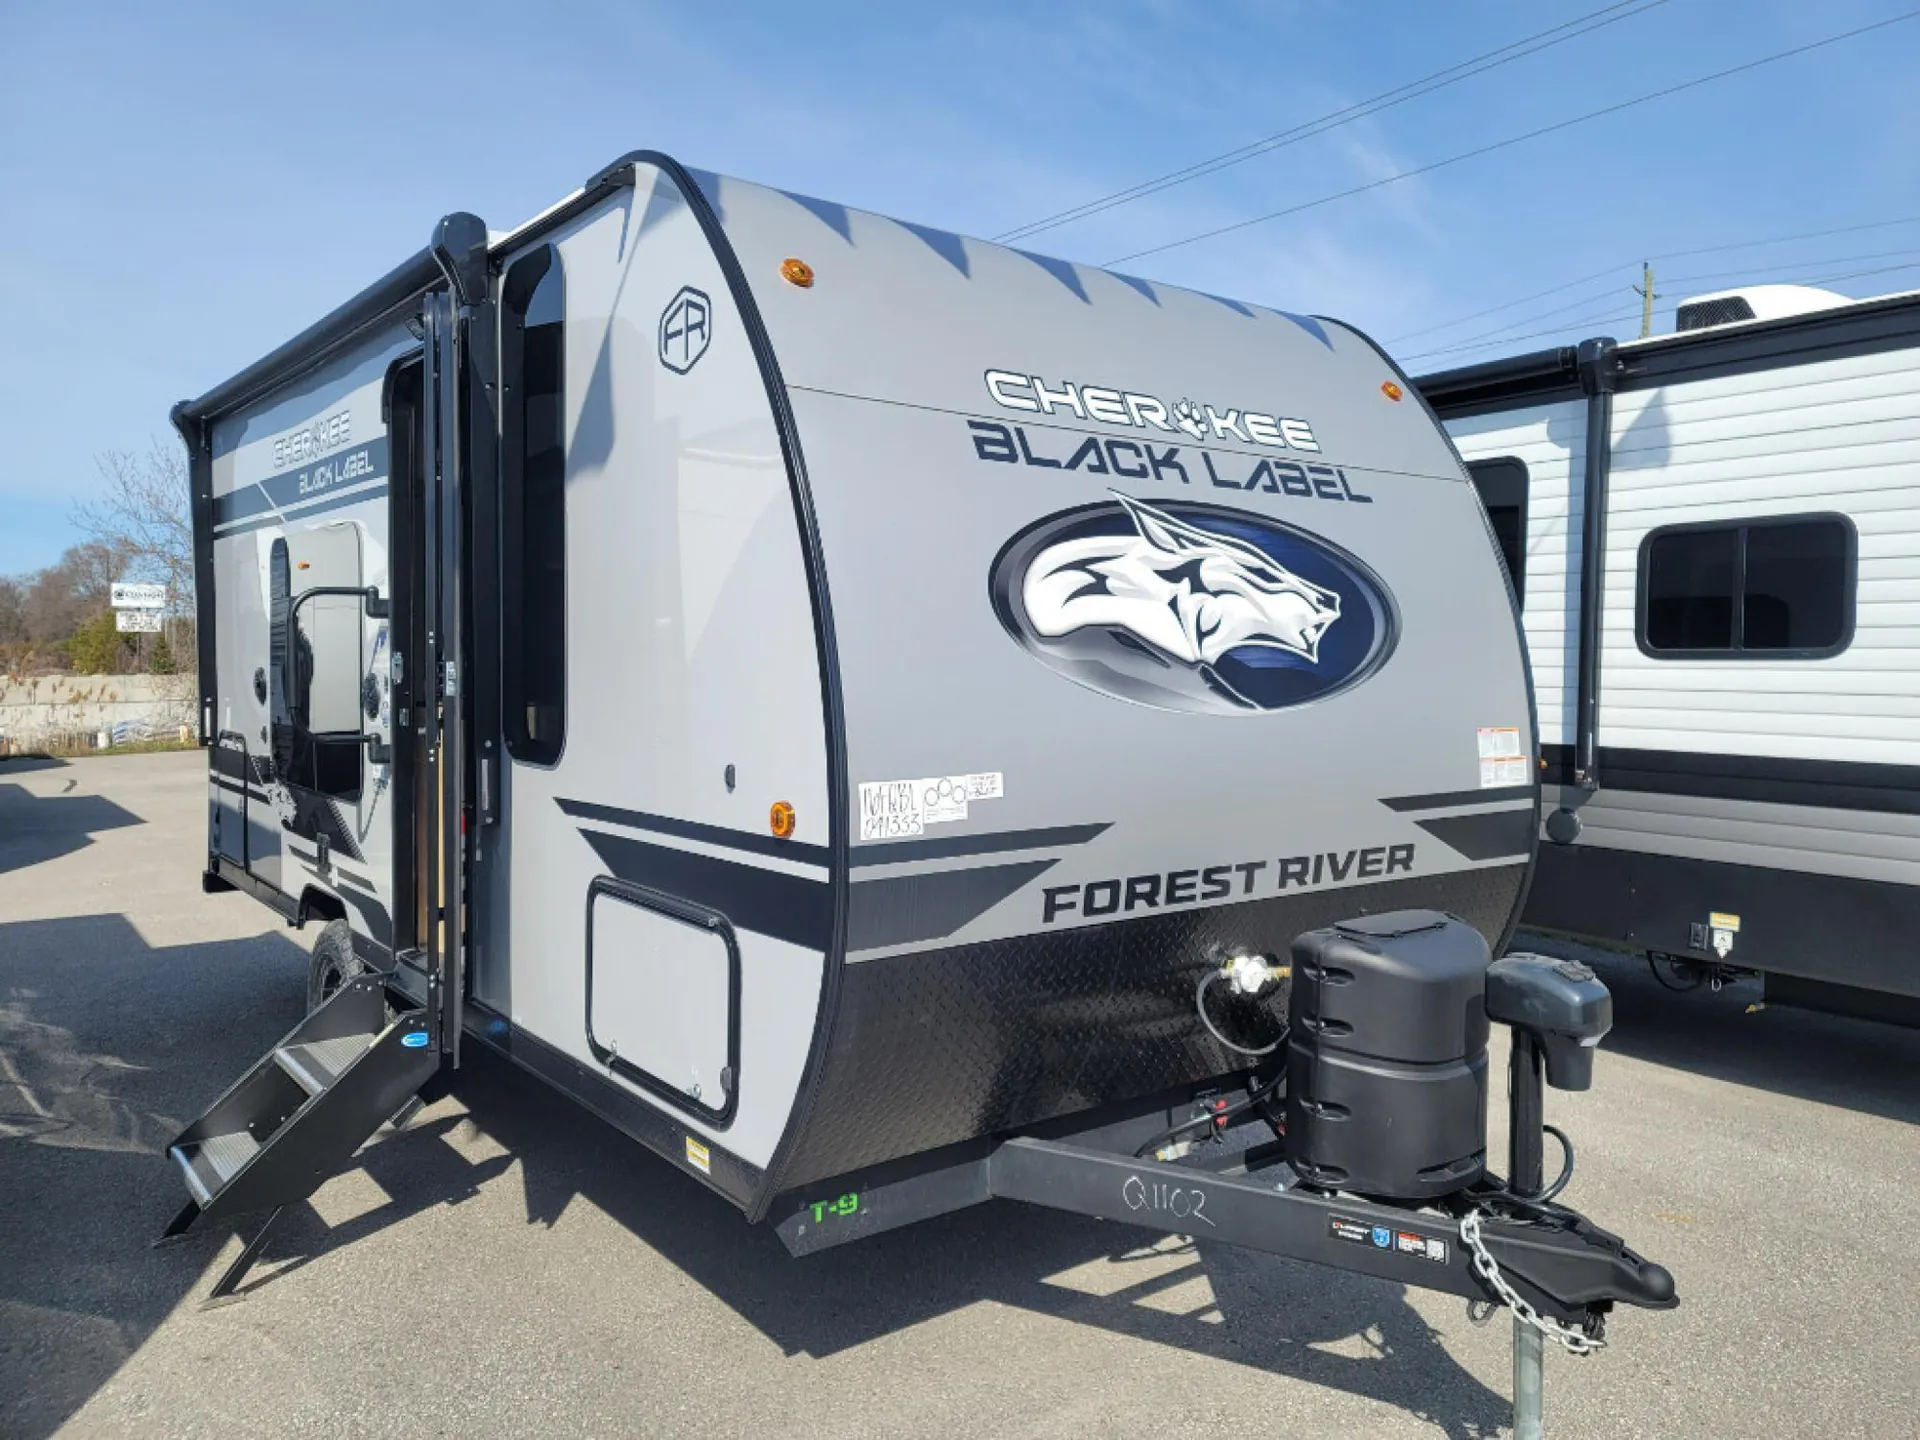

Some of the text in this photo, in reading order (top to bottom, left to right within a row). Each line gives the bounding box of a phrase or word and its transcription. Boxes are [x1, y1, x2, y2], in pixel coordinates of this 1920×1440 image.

[299, 449, 375, 495] BLACK LABEL
[967, 420, 1374, 503] BLACK LABEL
[1041, 843, 1416, 924] FOREST RIVER
[808, 1192, 859, 1224] T-9
[1122, 1175, 1217, 1228] Q1102
